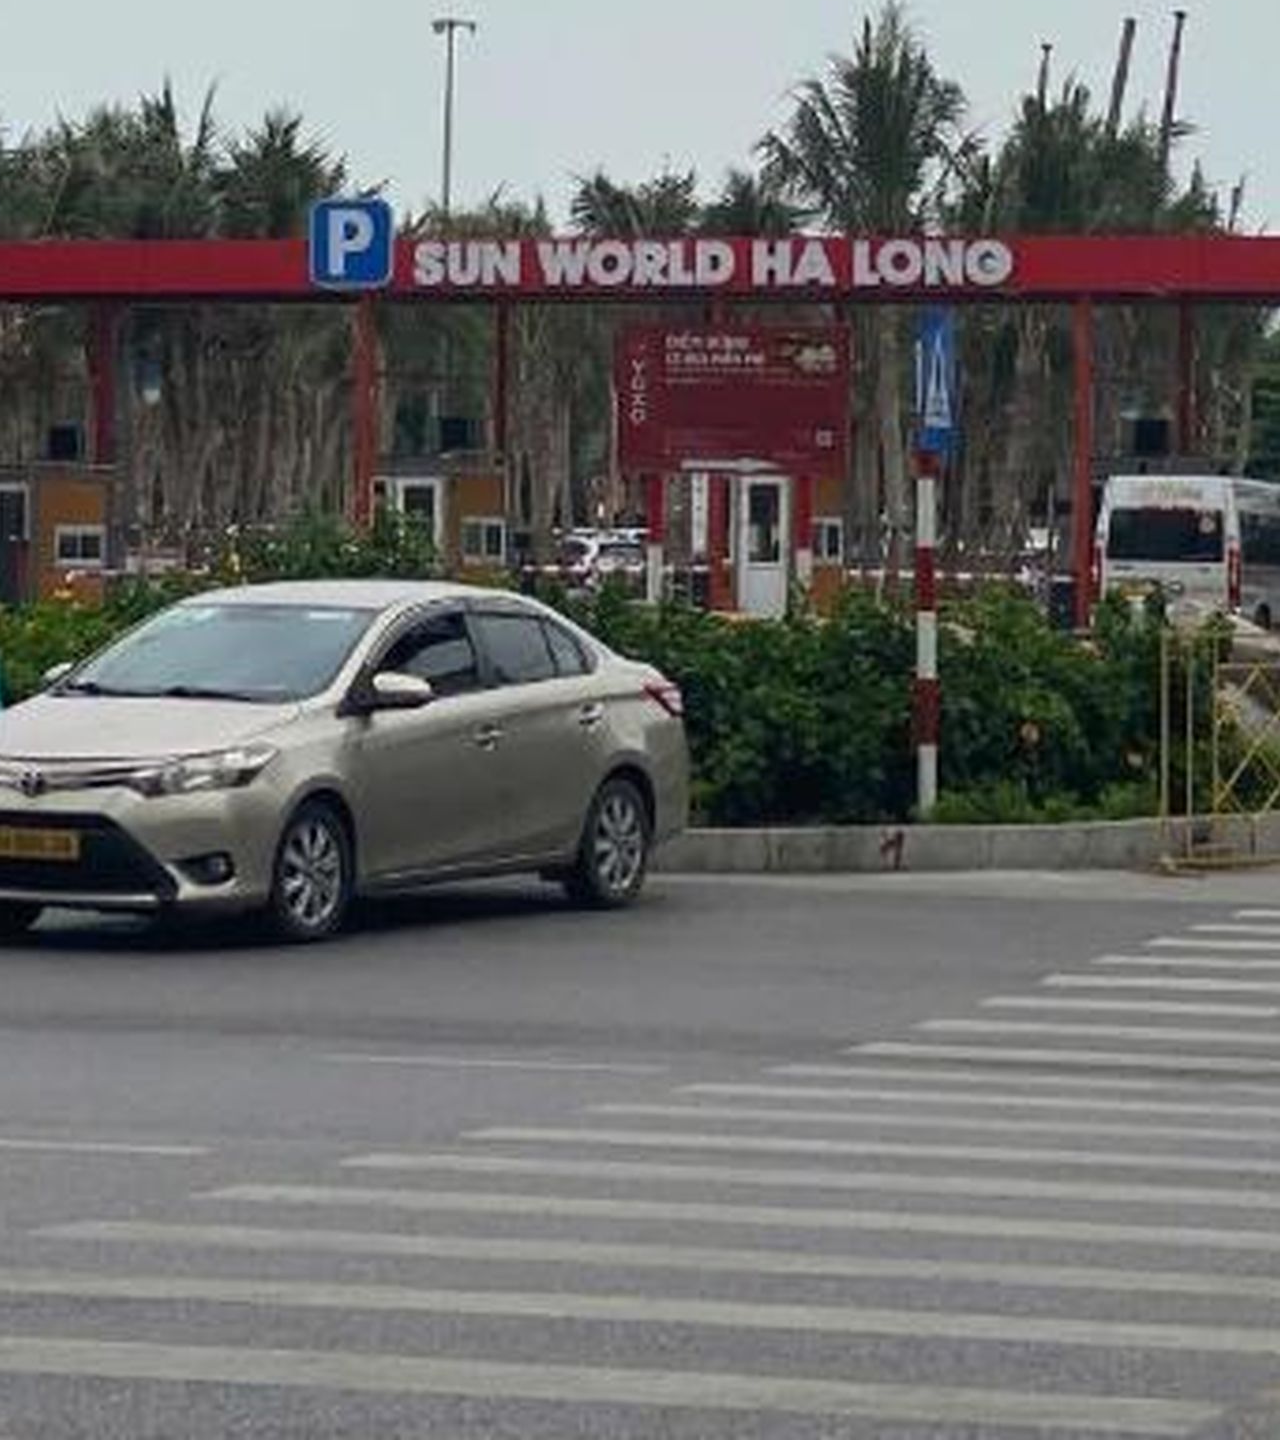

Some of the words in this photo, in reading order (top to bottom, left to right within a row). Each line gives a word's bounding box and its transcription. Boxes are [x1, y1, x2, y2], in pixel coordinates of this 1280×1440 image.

[327, 208, 375, 277] P
[414, 240, 519, 286] SUN
[538, 240, 735, 286] WORLD
[852, 239, 1013, 287] LONG
